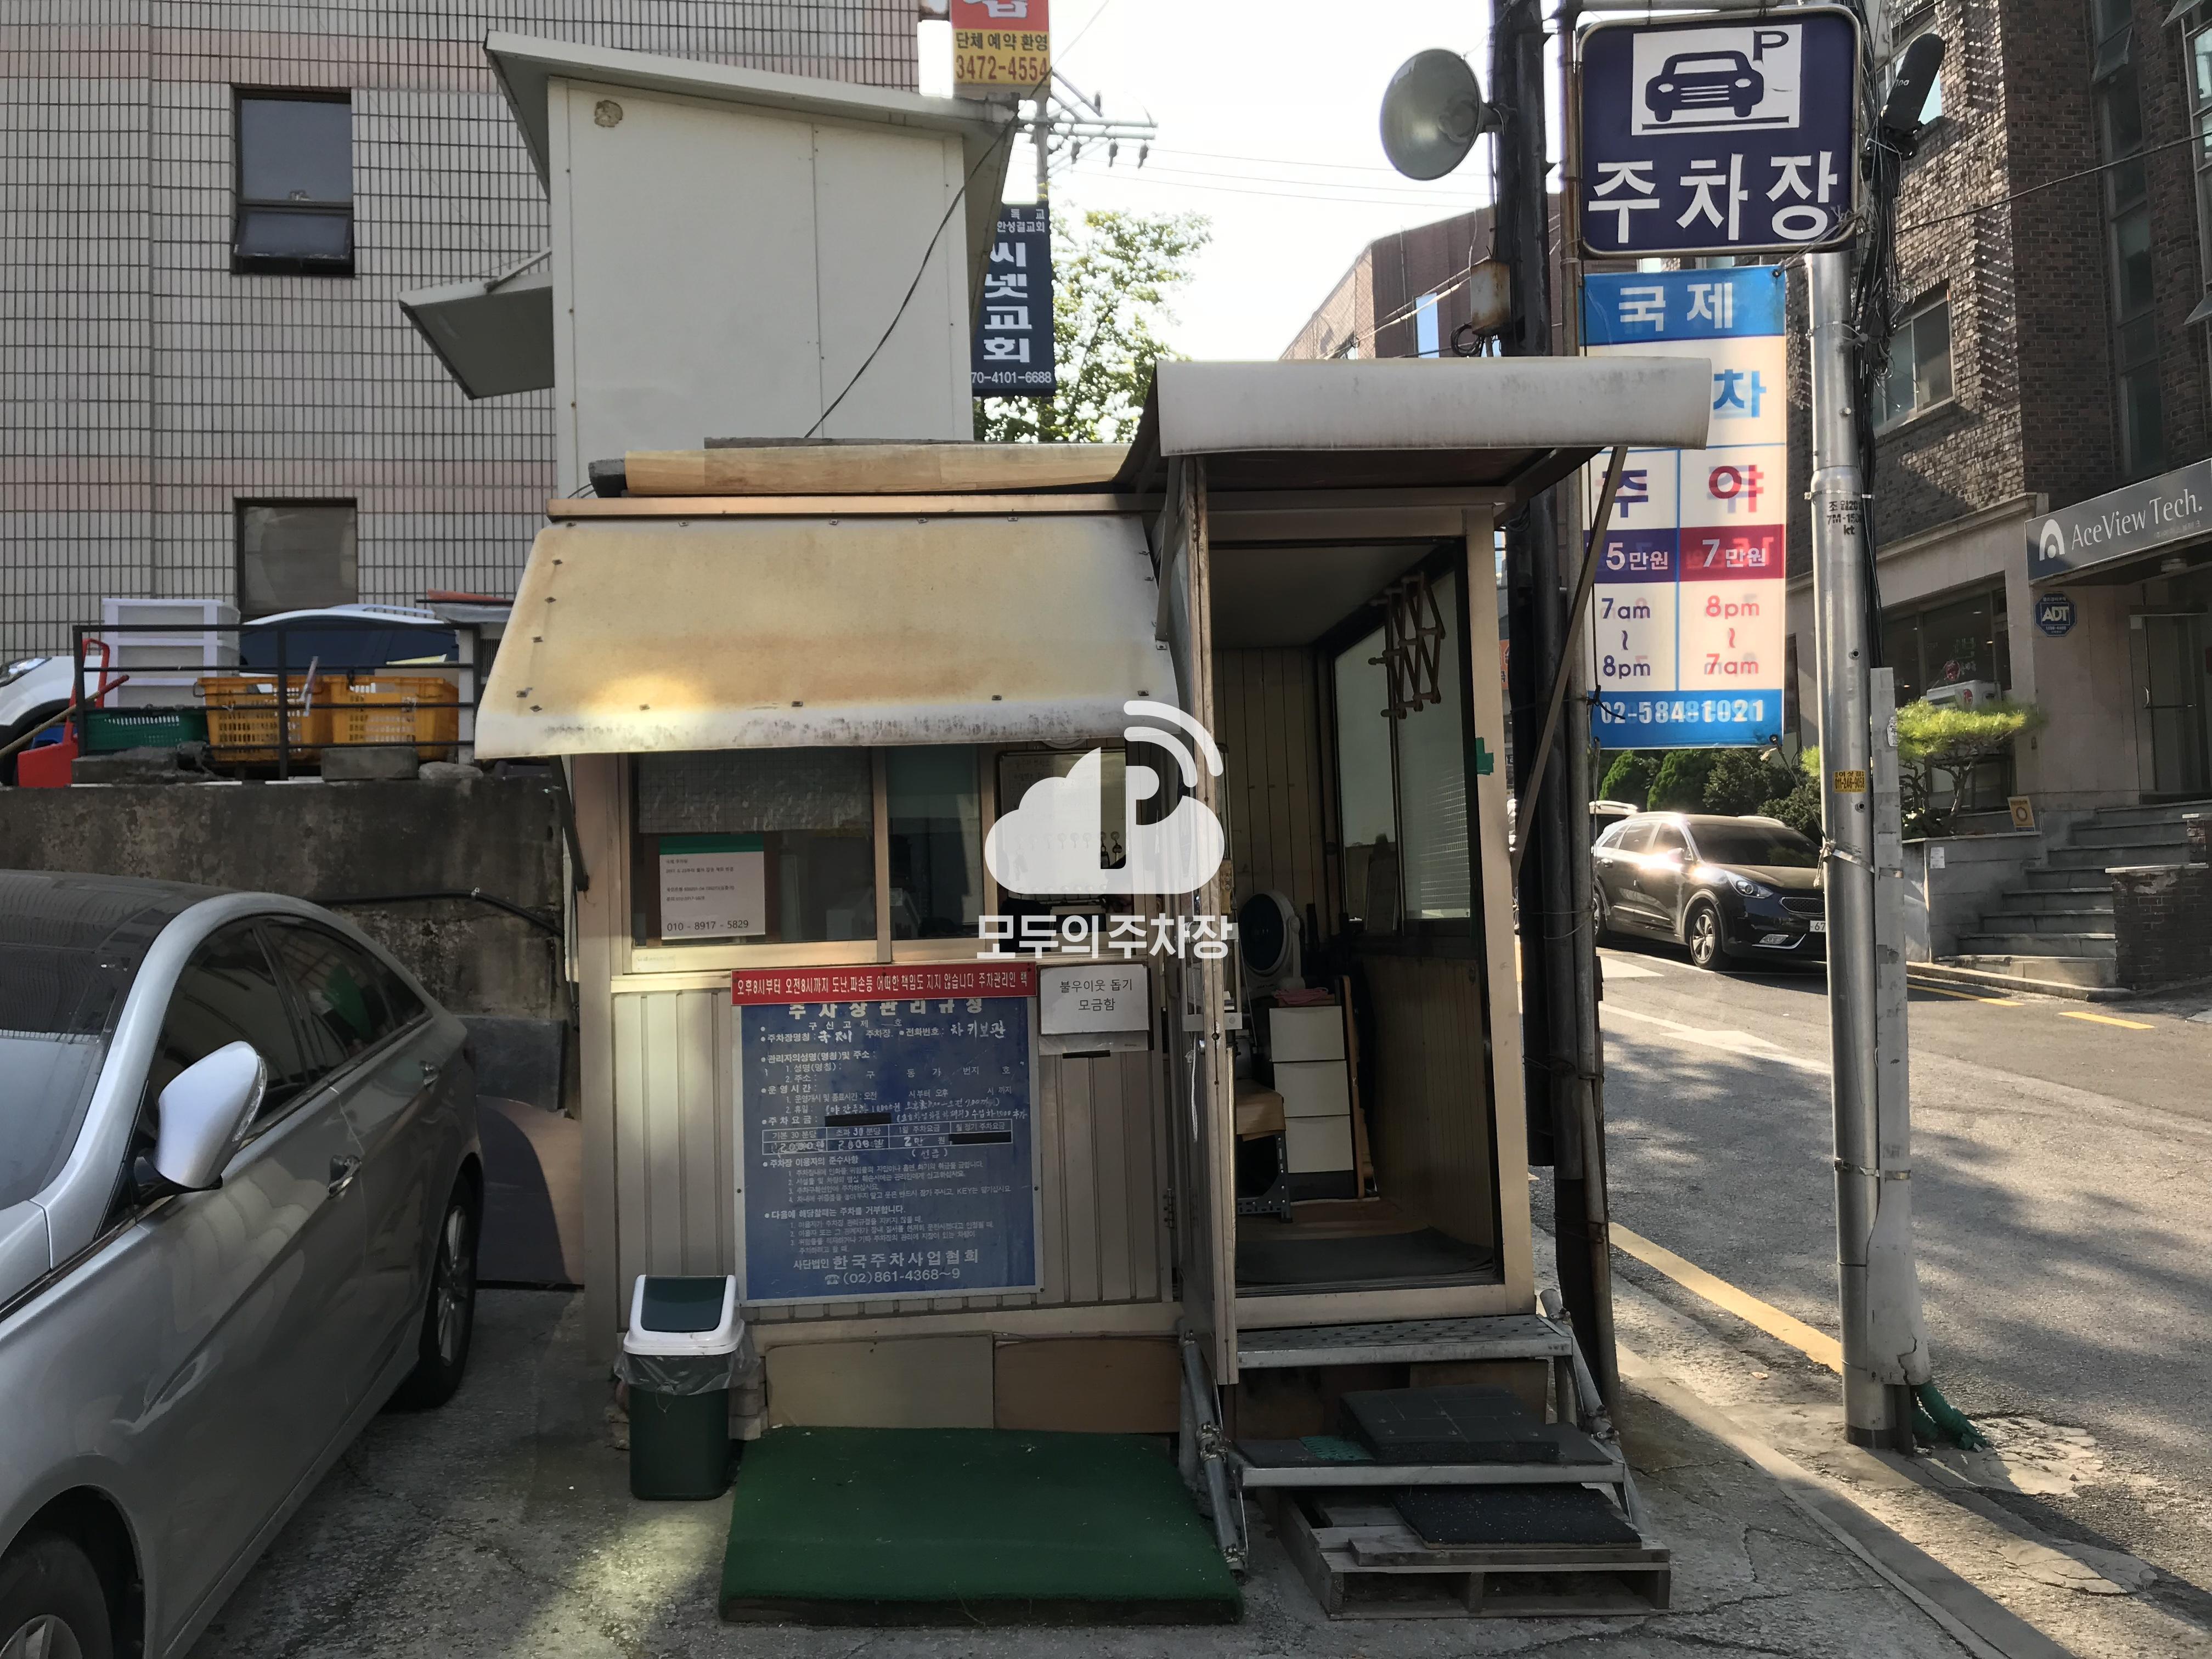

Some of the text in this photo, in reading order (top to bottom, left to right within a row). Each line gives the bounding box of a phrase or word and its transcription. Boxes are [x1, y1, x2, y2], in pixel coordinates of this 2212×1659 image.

[956, 32, 1048, 51] 단체 예약 환영
[956, 55, 1049, 81] 3472-4554
[1588, 150, 1838, 243] 주차장
[1619, 282, 1733, 331] 국제
[1709, 465, 1764, 513] 야
[2072, 510, 2146, 550] AceView
[1702, 539, 1767, 568] 7만원
[1601, 595, 1760, 619] 7am 8pm
[2042, 606, 2069, 622] ADT
[1602, 653, 1759, 679] 8pm 7am
[667, 919, 749, 932] 010 8917 5829
[737, 978, 780, 995] 오후8시부터
[786, 977, 829, 994] 오전8시까지
[1059, 979, 1132, 993] 불우이웃 돕기
[1078, 998, 1116, 1011] 모금함
[770, 1159, 792, 1168] 주차장
[793, 1259, 830, 1270] 사단법인
